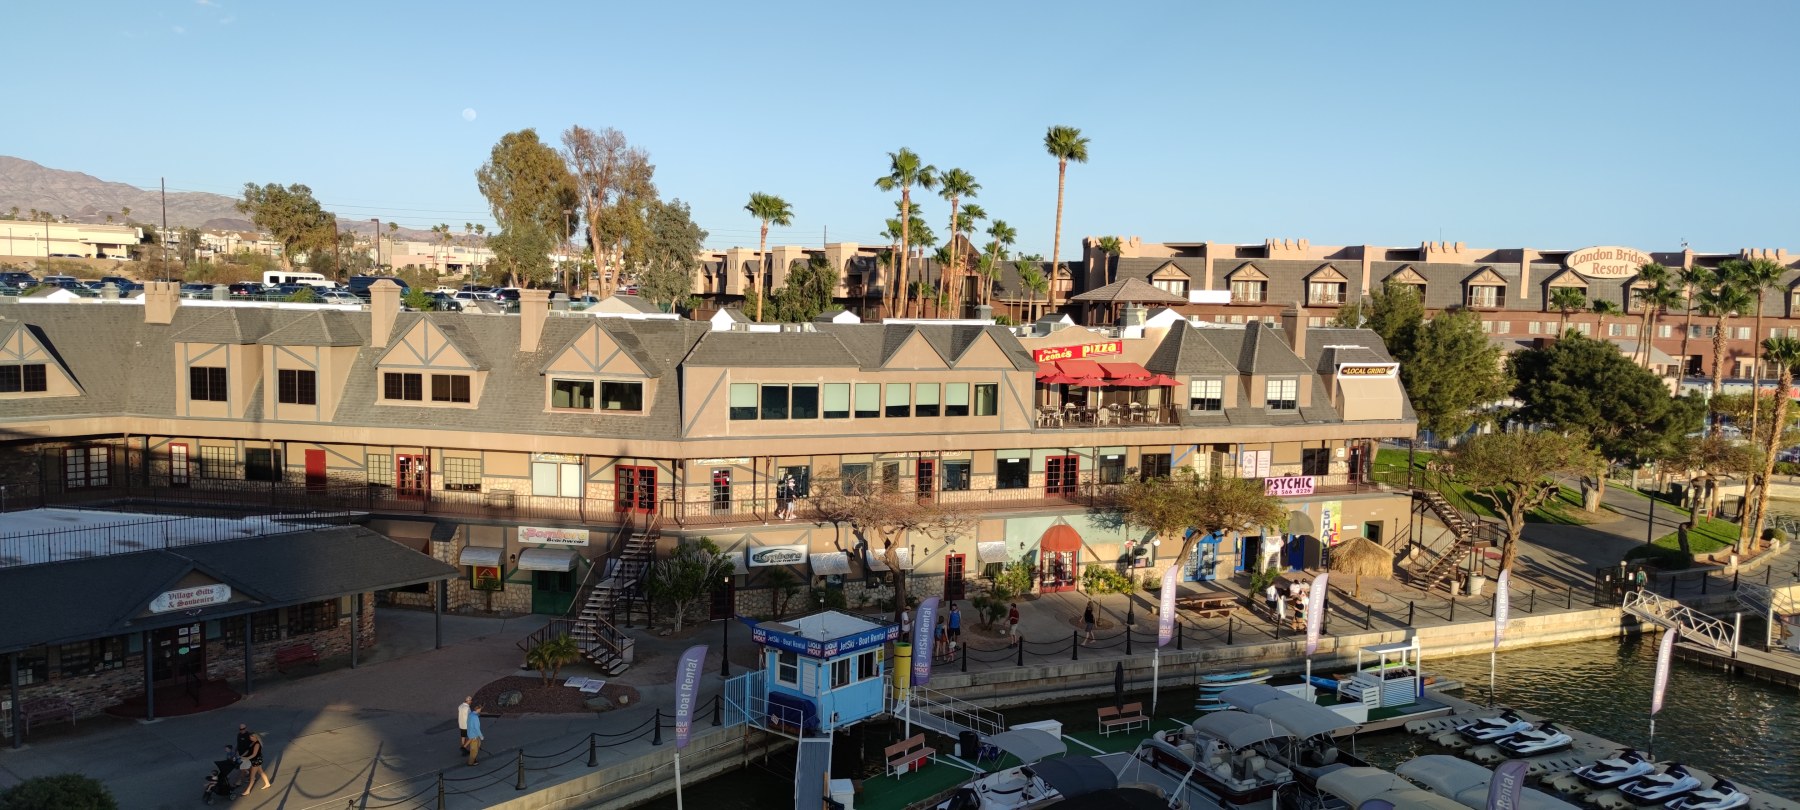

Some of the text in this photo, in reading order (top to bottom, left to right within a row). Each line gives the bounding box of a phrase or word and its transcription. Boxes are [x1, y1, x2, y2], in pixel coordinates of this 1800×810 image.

[1573, 248, 1649, 267] London Bridge
[1592, 263, 1628, 275] Resort
[1082, 343, 1117, 358] pizza
[1346, 367, 1366, 375] LOCAL
[1267, 478, 1312, 490] PSYCHIC
[168, 588, 214, 601] Village Gifts
[177, 596, 214, 606] Souvenirs
[753, 628, 766, 636] LIQUI
[887, 625, 900, 634] LIQUI
[918, 607, 932, 659] JetSki Rental
[753, 635, 766, 643] MOLY
[840, 631, 886, 651] JetSki Boat Rental
[887, 632, 899, 641] MOLY
[807, 641, 821, 650] LIQUI
[824, 641, 837, 650] LIQUI
[807, 648, 821, 657] MOLY
[824, 648, 837, 658] MOLY
[682, 658, 698, 690] Rental
[677, 694, 691, 716] Boat
[1496, 772, 1516, 810] Rental
